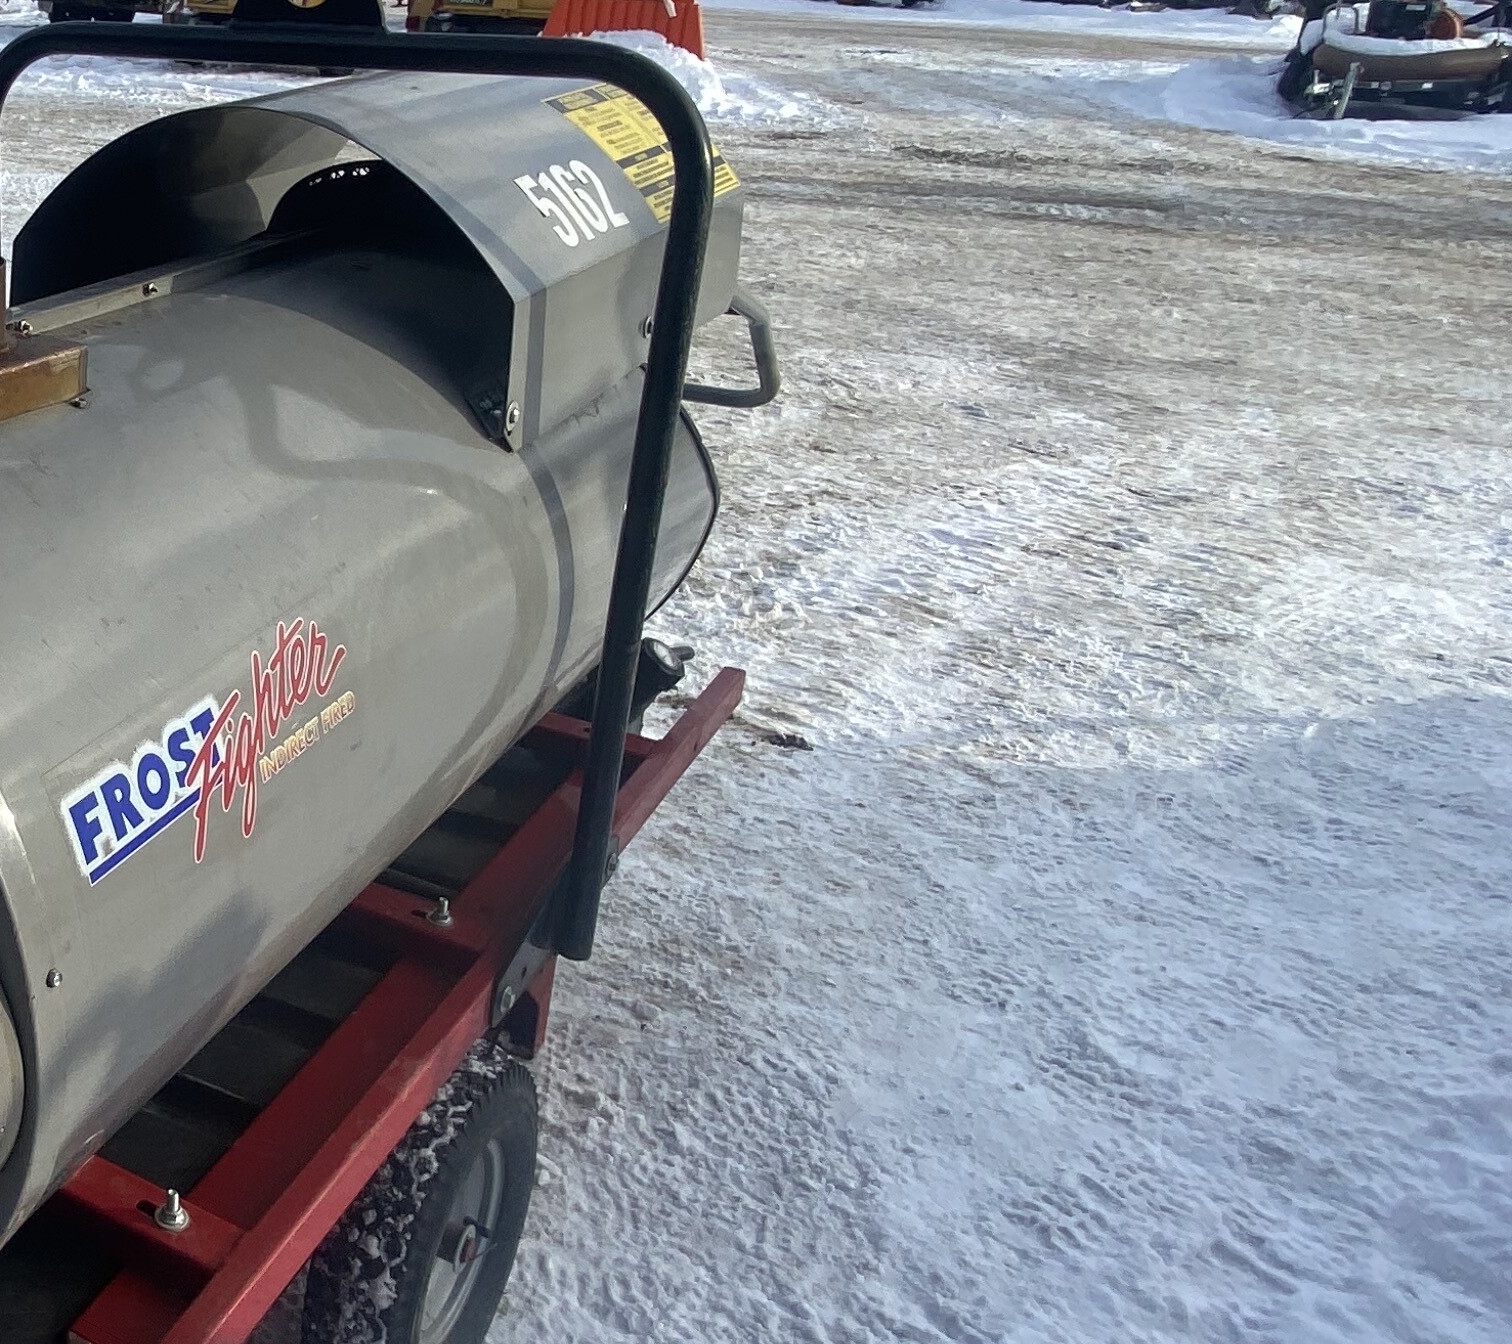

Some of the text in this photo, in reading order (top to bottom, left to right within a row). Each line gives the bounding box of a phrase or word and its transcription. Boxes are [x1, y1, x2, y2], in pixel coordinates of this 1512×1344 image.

[513, 160, 630, 247] 5162
[68, 617, 347, 866] FROST Fighter
[259, 690, 356, 783] INDIRECT FIRED
